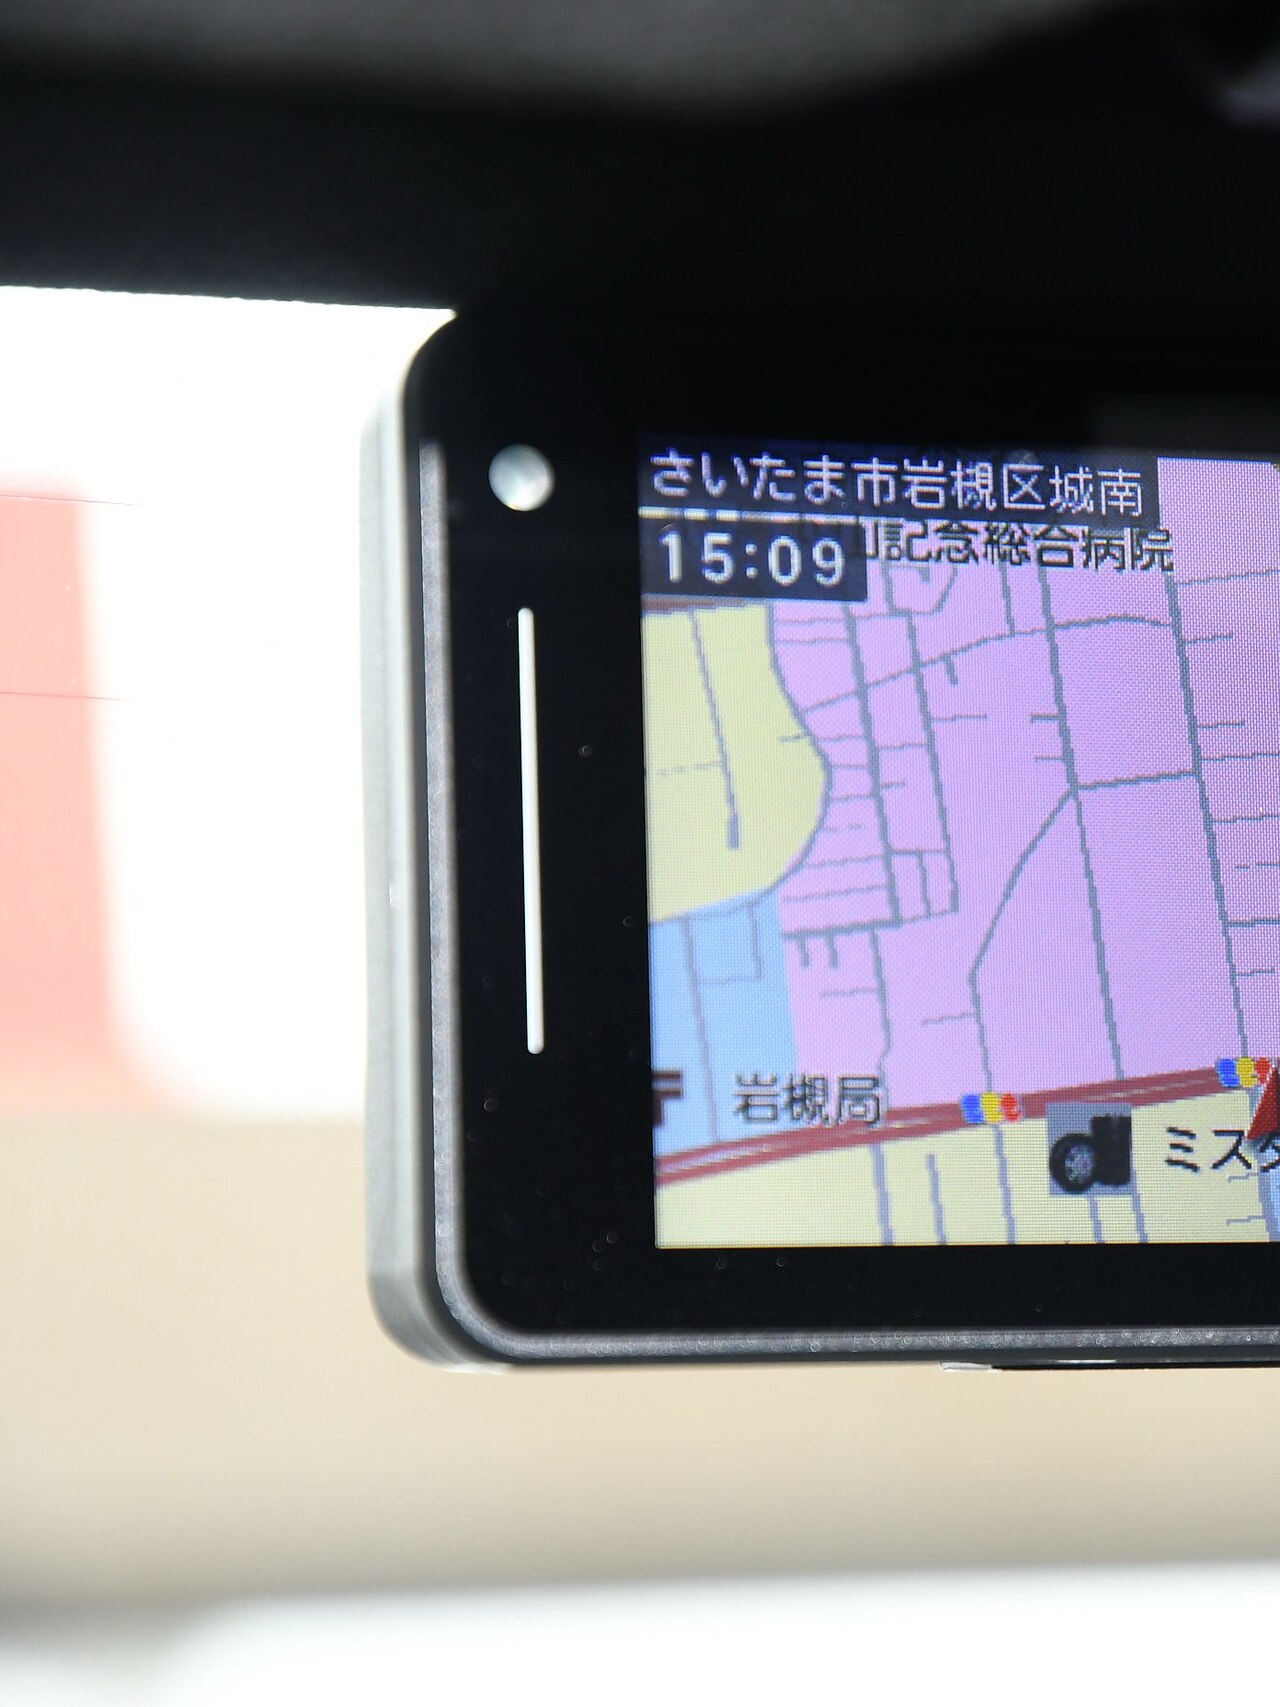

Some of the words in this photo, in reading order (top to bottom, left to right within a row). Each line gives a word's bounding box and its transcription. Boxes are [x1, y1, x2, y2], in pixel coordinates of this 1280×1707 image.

[650, 449, 1143, 518] さいたま市岩槻区城南
[660, 529, 846, 587] 15:09
[866, 517, 1175, 572] 記念総合病院
[734, 1072, 881, 1128] 岩槻局
